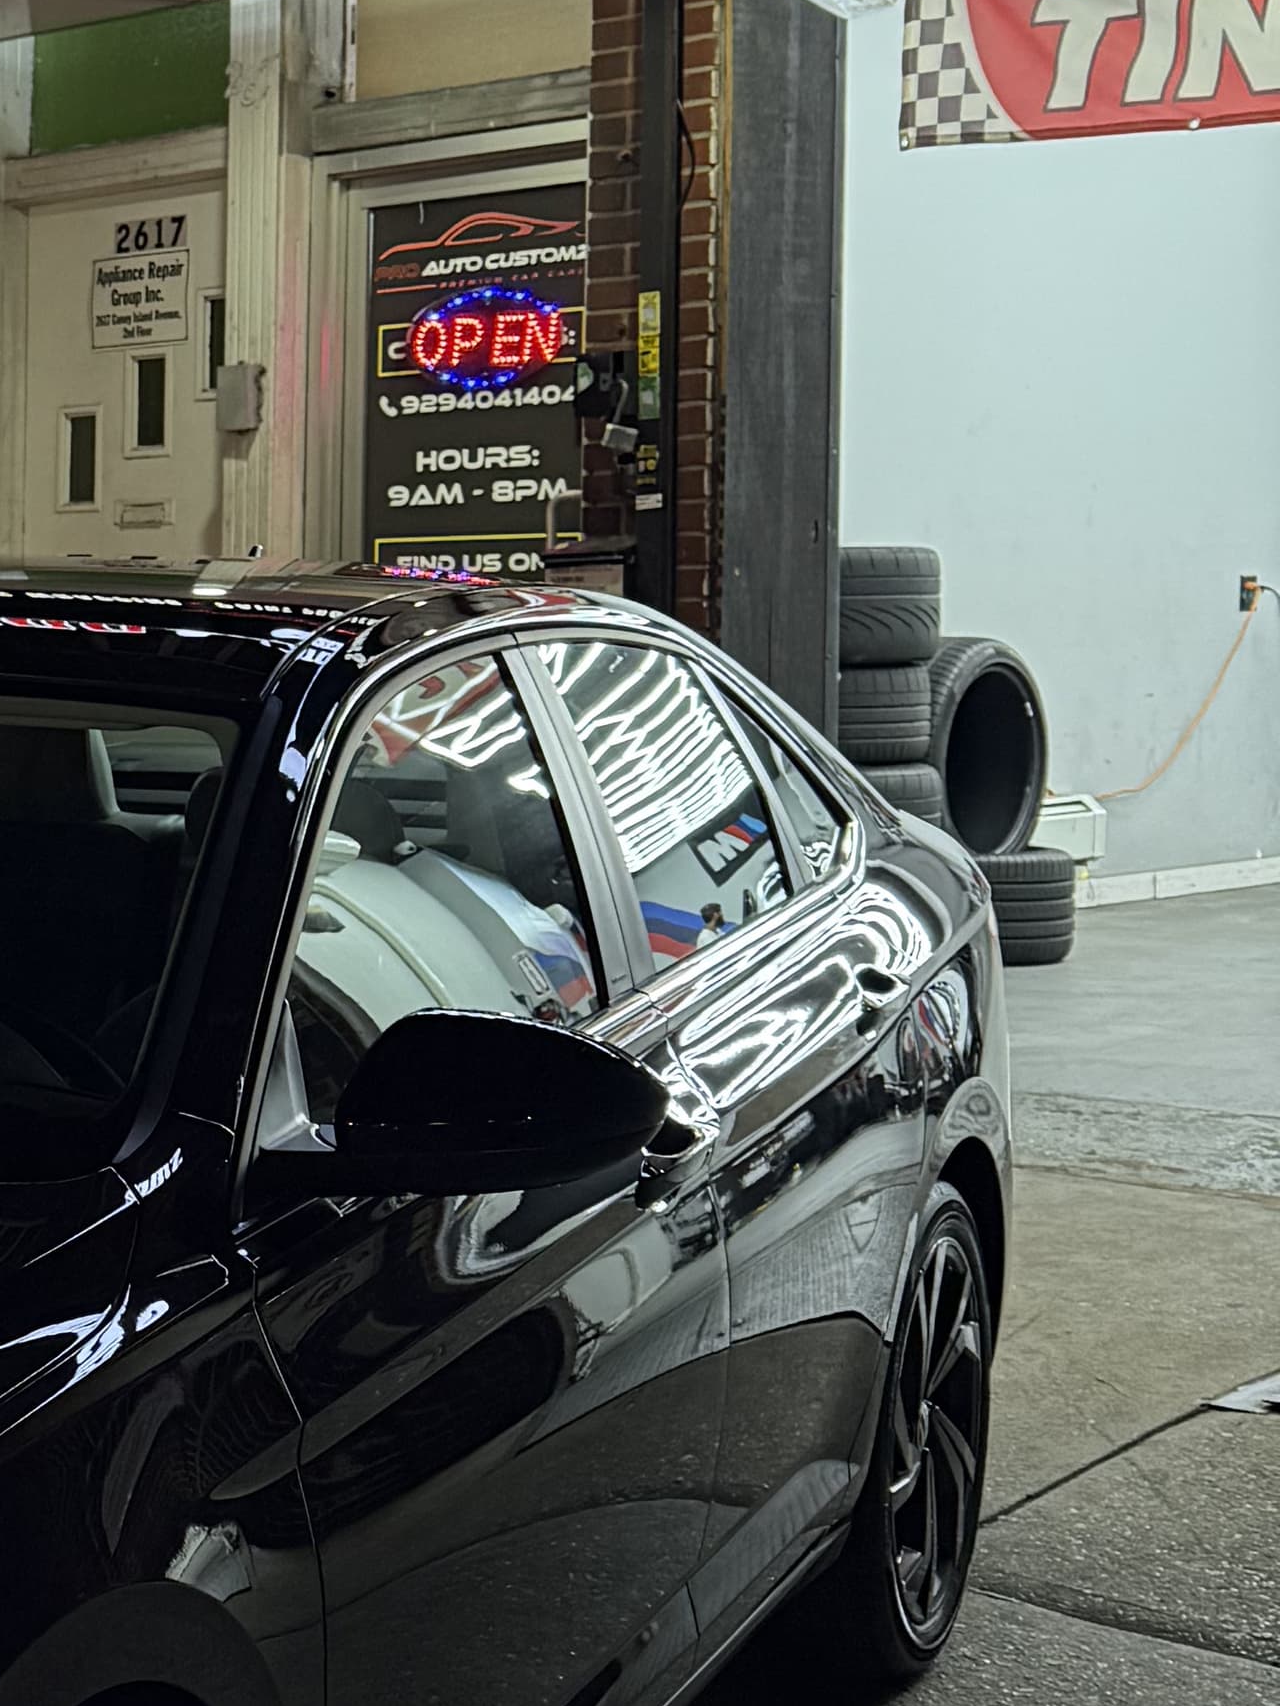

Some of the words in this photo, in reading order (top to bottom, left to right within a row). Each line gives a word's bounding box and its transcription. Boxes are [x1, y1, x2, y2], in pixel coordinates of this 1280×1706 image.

[116, 214, 187, 254] 2617
[96, 265, 145, 288] Appliance
[147, 258, 184, 282] Repair
[421, 255, 484, 277] AUTO
[111, 288, 142, 307] Group
[145, 285, 165, 304] Inc.
[412, 311, 563, 367] OPEN
[416, 445, 541, 473] HOURS:
[388, 482, 465, 508] 9AM
[491, 478, 568, 503] 8PM
[396, 555, 455, 571] FIND
[462, 552, 503, 573] US
